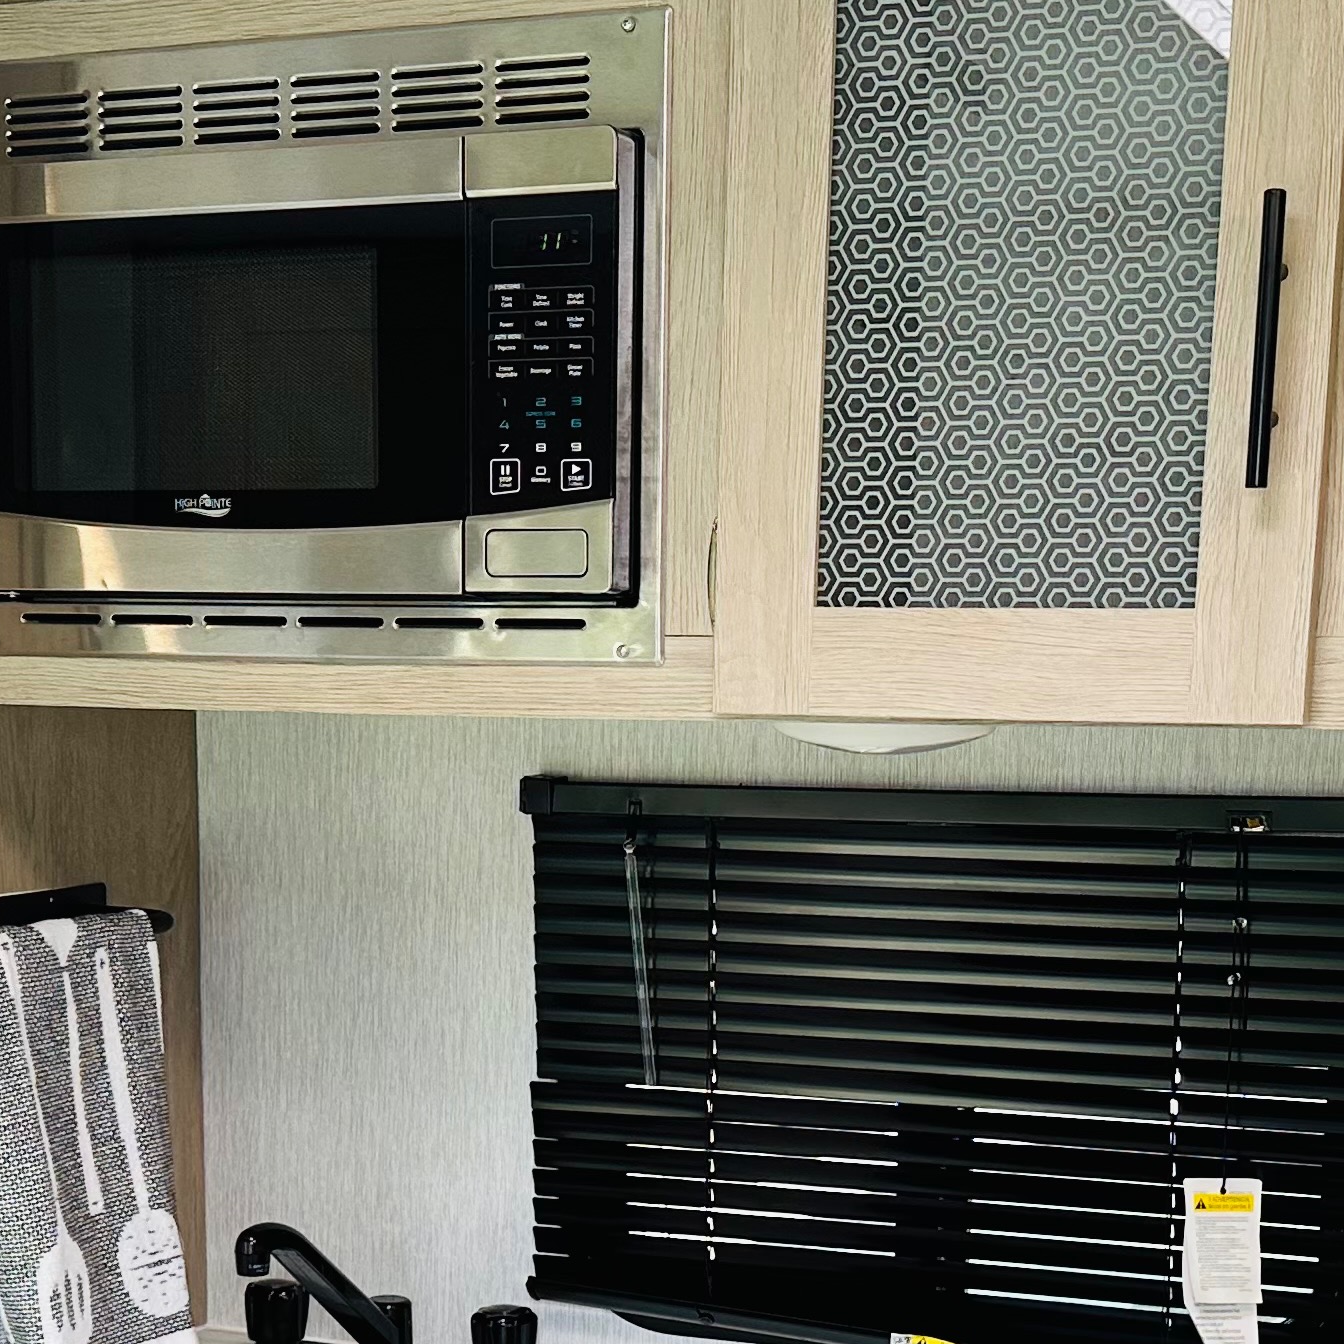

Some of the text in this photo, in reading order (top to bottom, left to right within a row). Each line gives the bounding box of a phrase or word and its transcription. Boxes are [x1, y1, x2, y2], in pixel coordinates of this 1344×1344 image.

[536, 397, 546, 407] 2
[571, 396, 582, 406] 3
[499, 418, 582, 429] 4 5 6
[499, 442, 582, 453] 7 8 9
[536, 466, 546, 475] 0
[175, 497, 232, 511] HIGH POINTE
